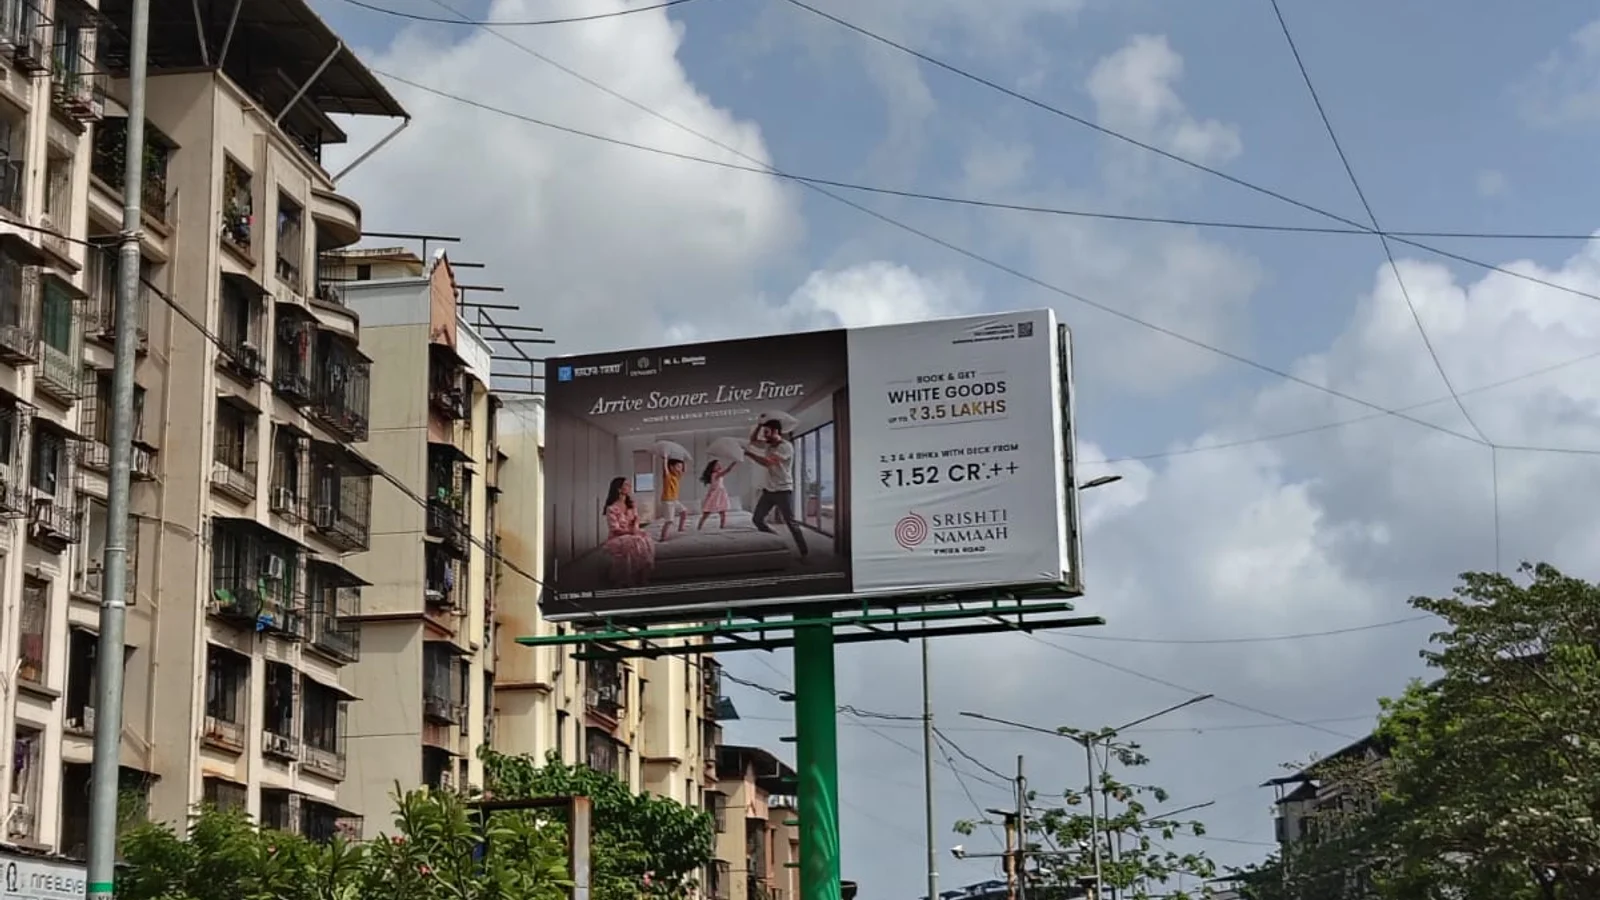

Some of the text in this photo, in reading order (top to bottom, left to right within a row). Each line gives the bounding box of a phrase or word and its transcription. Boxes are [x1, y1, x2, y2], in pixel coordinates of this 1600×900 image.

[917, 375, 944, 383] BOOK
[958, 371, 976, 379] GET
[589, 380, 804, 415] Arrive Sooner. Live Finer.
[888, 381, 1006, 404] WHITE GOODS
[951, 400, 1006, 417] LAKHS
[941, 448, 964, 457] WITH
[993, 444, 1019, 452] FROM
[880, 466, 939, 487] ₹1.52
[932, 509, 1007, 527] SRISHTI
[934, 527, 1008, 544] NAMAAH
